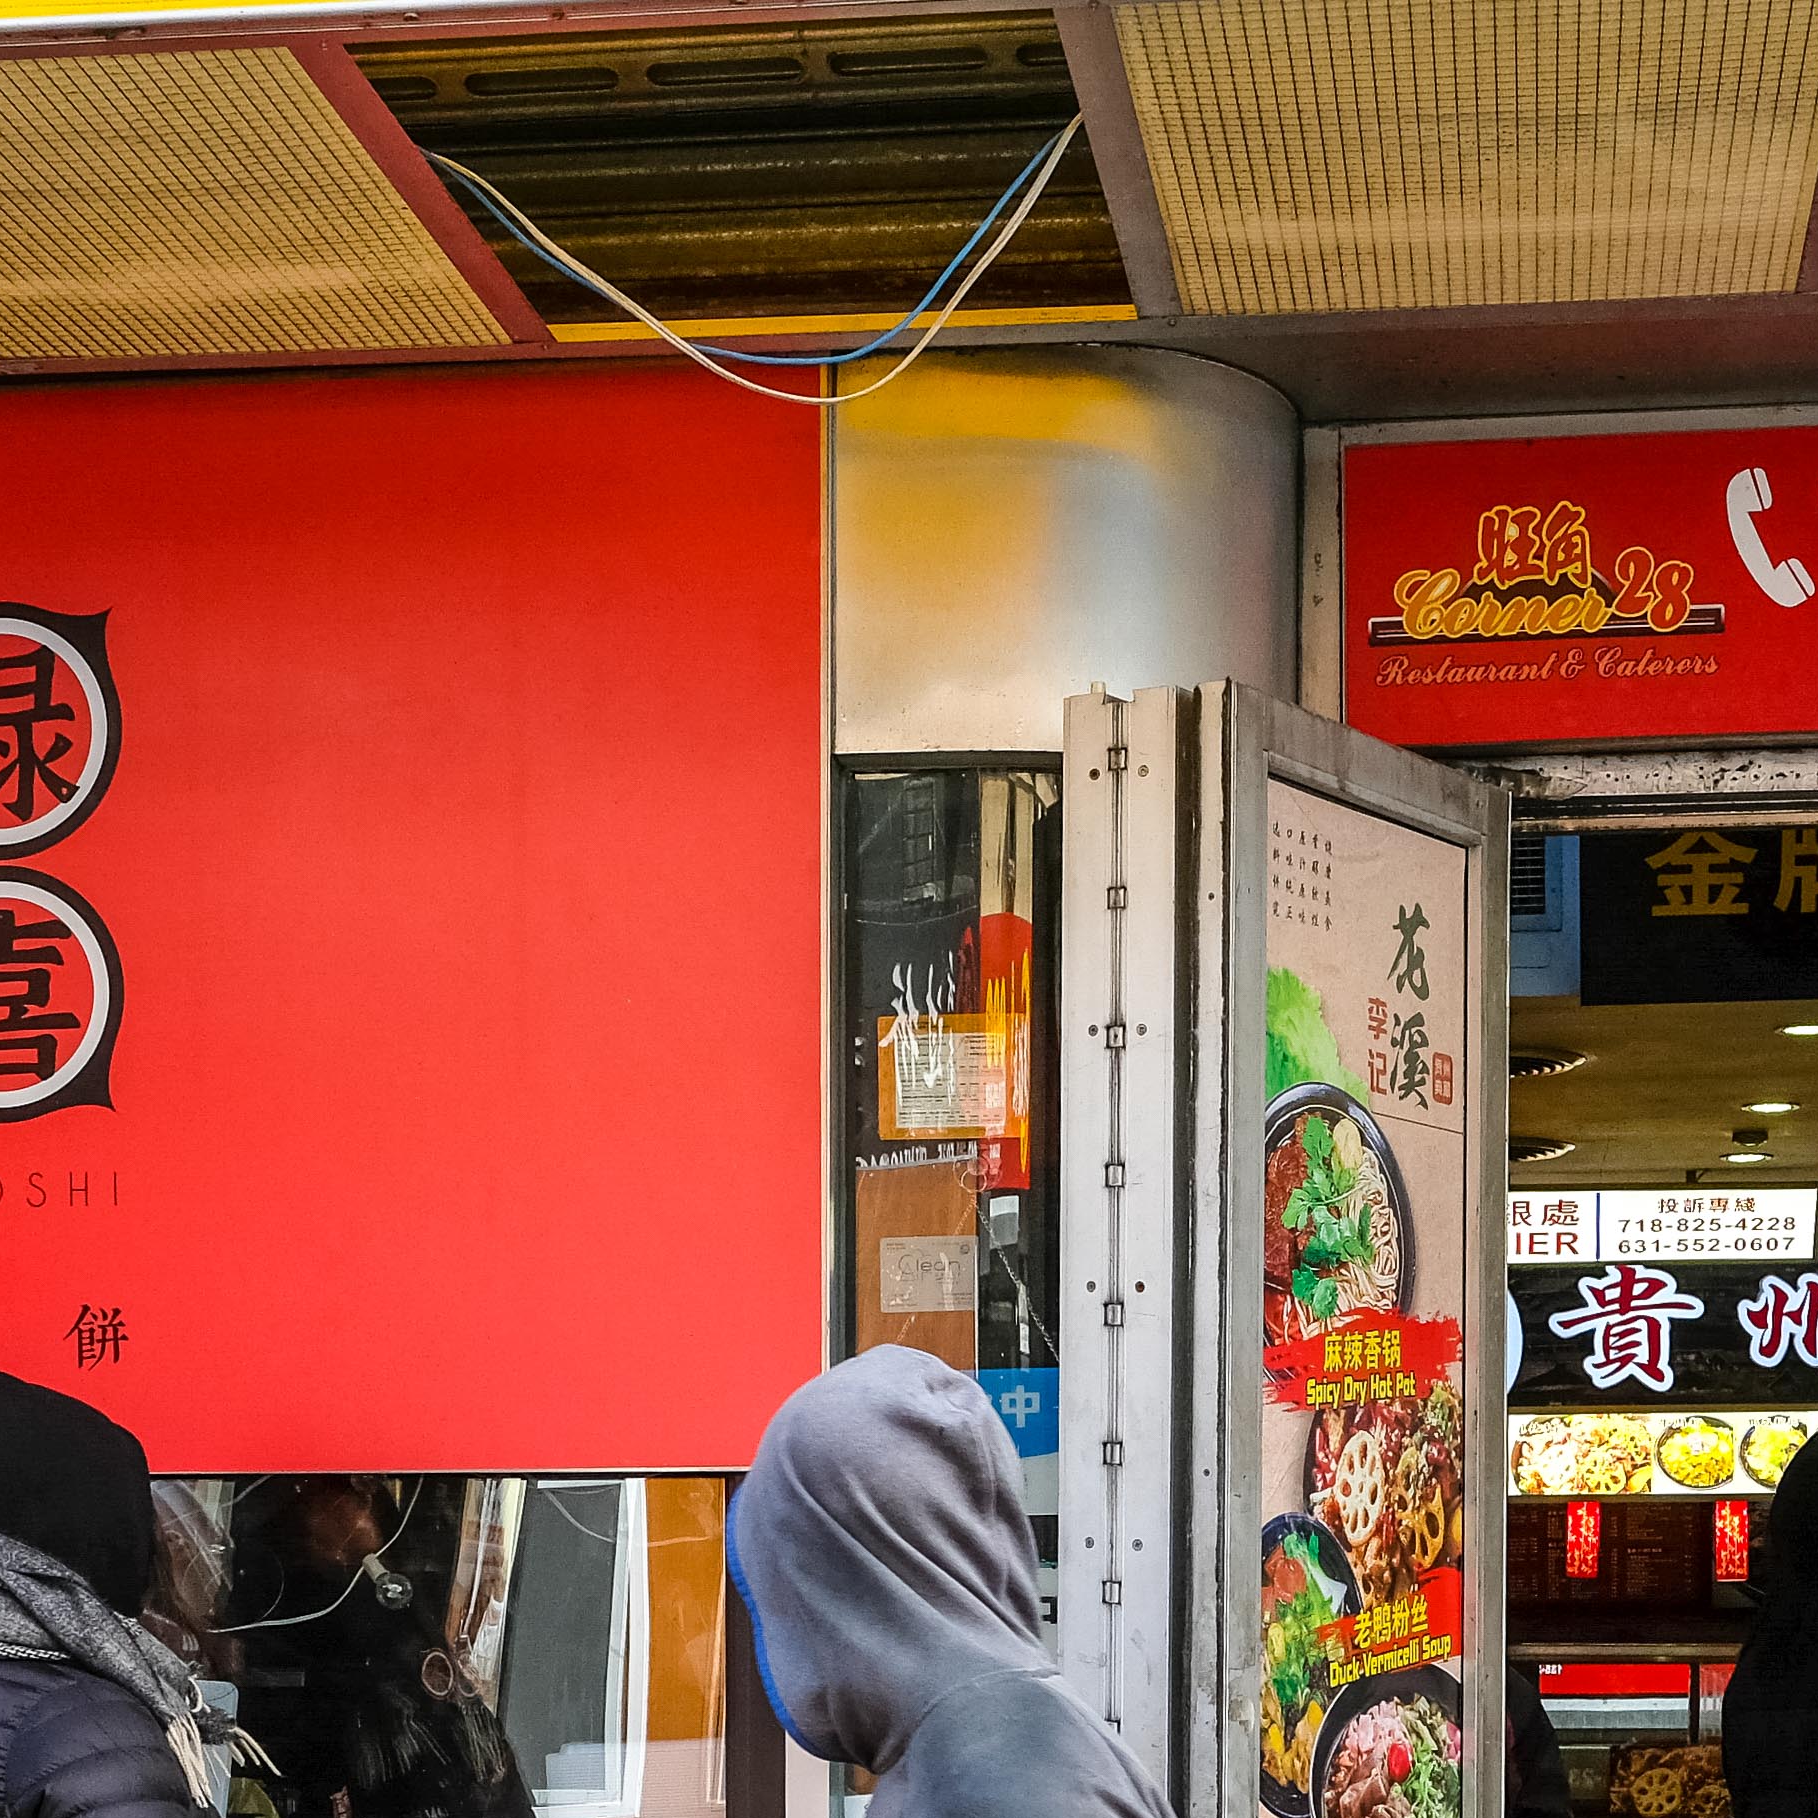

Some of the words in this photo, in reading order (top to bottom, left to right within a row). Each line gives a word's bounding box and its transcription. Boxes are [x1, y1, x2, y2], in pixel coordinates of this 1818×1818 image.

[1394, 569, 1613, 639] Corner
[1613, 547, 1694, 632] 28
[1376, 651, 1558, 686] Restaurant
[1559, 649, 1584, 677] &
[1595, 646, 1719, 678] Caterers
[1618, 1217, 1796, 1232] 718-825-4228
[1618, 1237, 1795, 1253] 631-552-0607
[1323, 1329, 1401, 1372] 麻辣香锅
[1306, 1378, 1340, 1411] Spicy
[1344, 1376, 1367, 1407] Dry
[1370, 1373, 1393, 1400] Hot
[1396, 1371, 1415, 1398] Pot
[1353, 1595, 1428, 1649] 老鸭粉丝
[1329, 1656, 1360, 1688] Duck
[1362, 1638, 1420, 1677] Vermicelli
[1422, 1634, 1451, 1661] Soup
